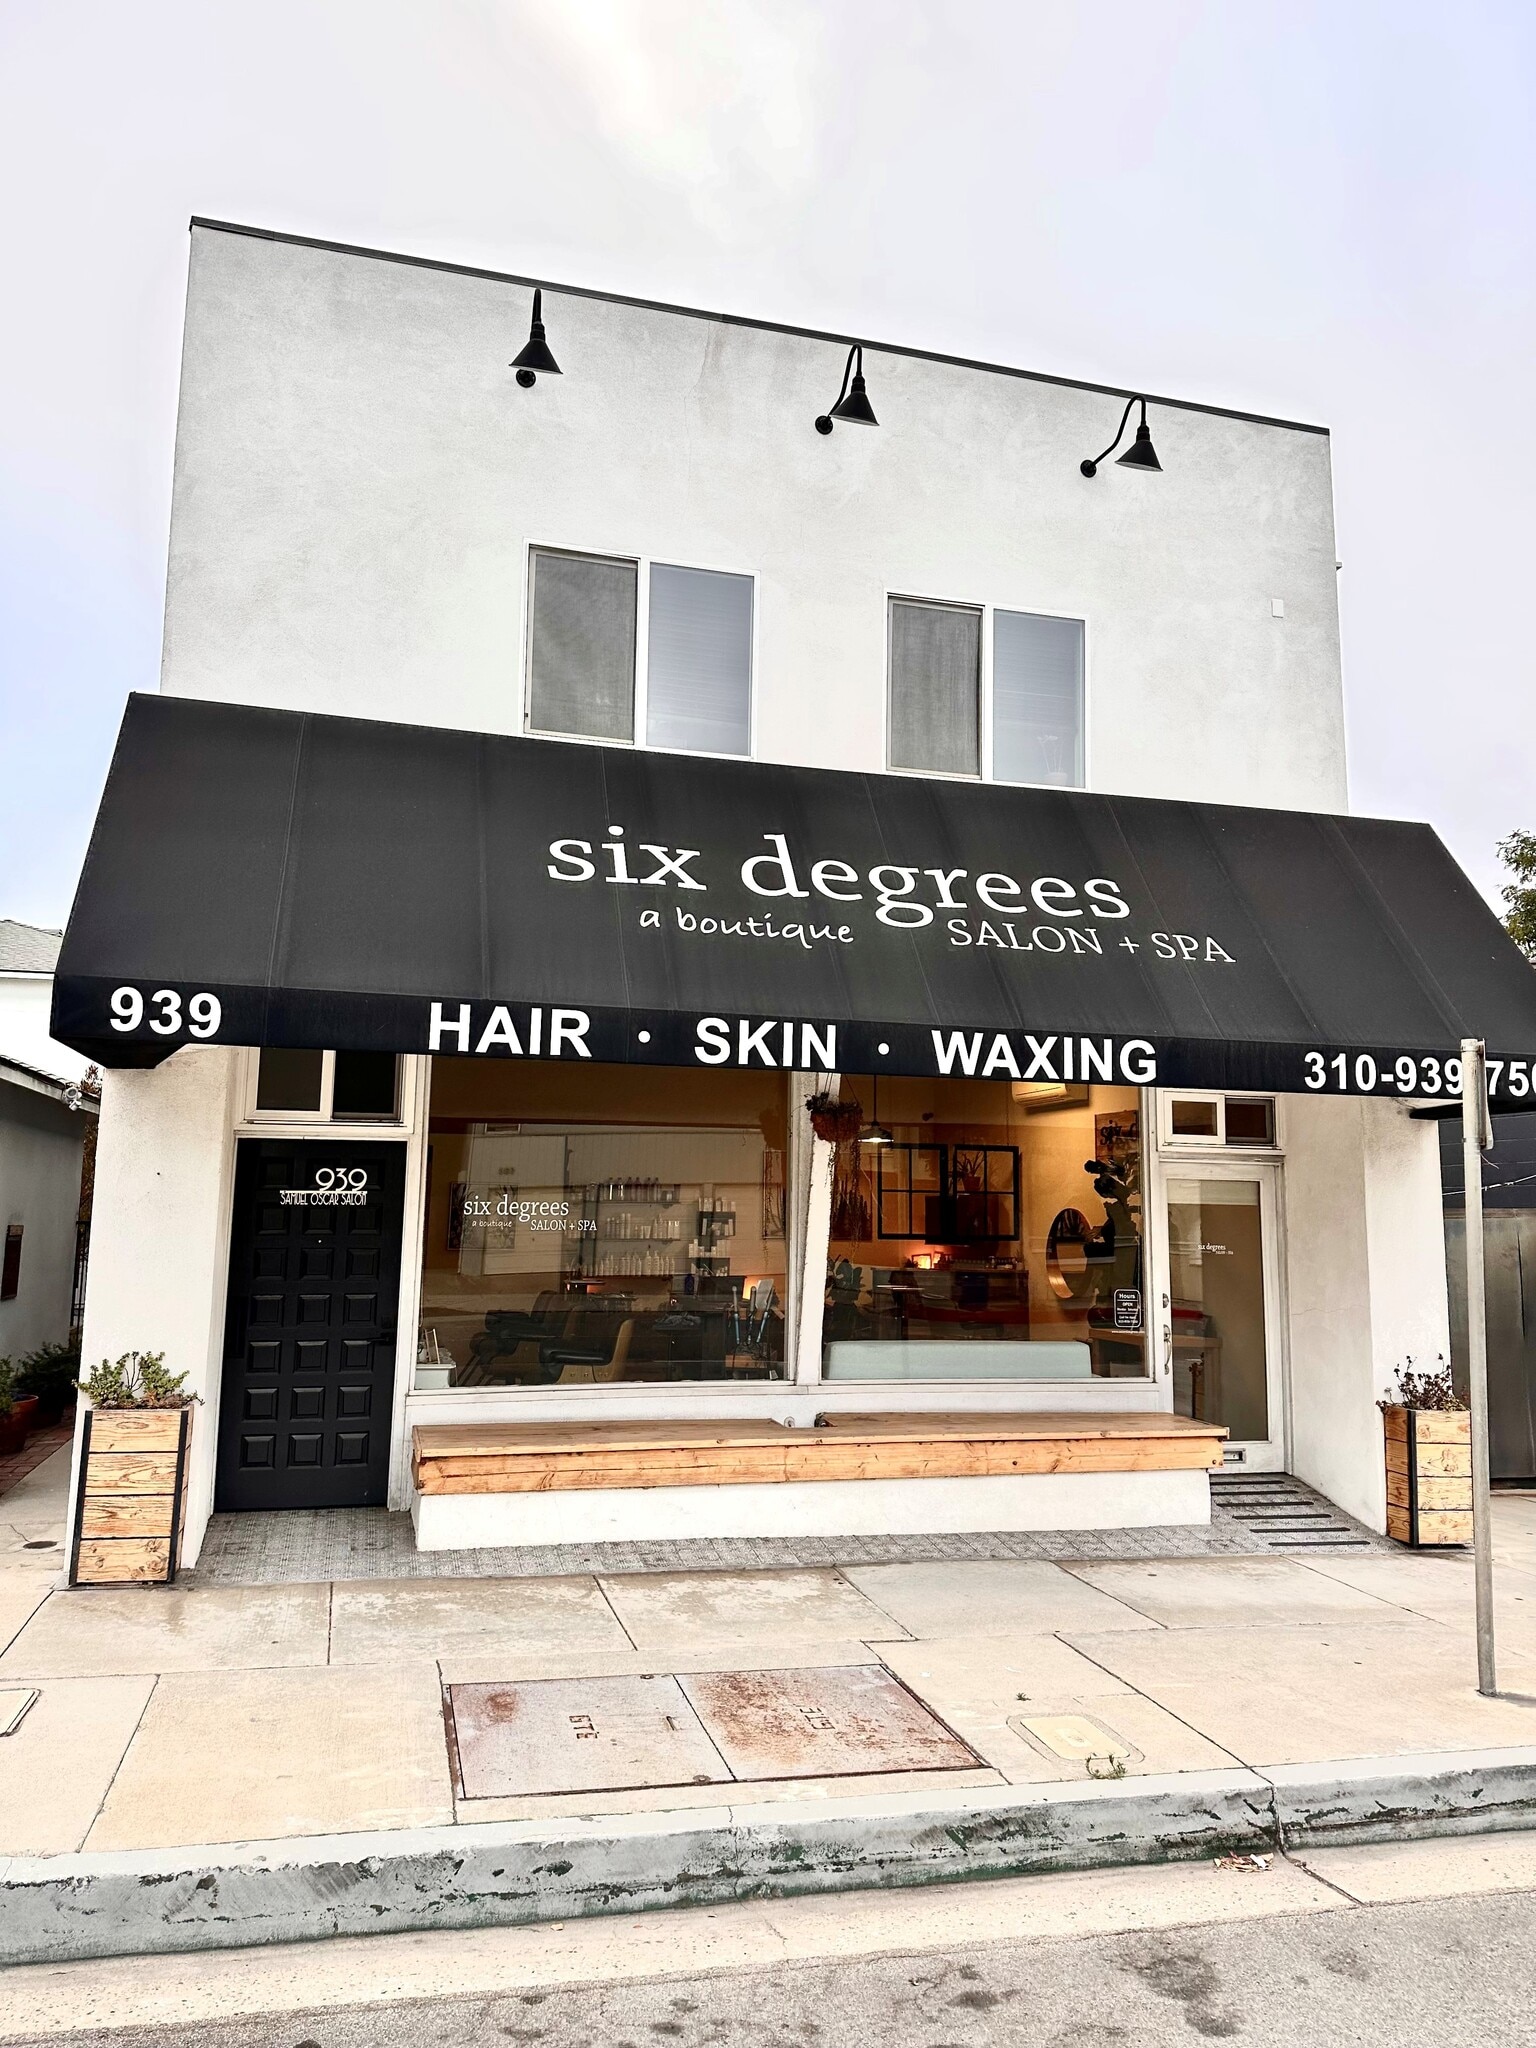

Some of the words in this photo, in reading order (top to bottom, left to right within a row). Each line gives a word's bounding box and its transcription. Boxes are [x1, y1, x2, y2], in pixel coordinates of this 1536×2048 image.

[547, 825, 706, 891] six
[740, 833, 1130, 928] degrees
[639, 910, 661, 928] a
[675, 906, 854, 948] boutique
[947, 918, 1103, 955] SALON
[1118, 936, 1140, 954] +
[1150, 932, 1237, 964] SPA
[109, 986, 222, 1039] 939
[428, 1002, 592, 1057] HAIR
[694, 1017, 836, 1070] SKIN
[931, 1029, 1157, 1084] WAXING
[315, 1167, 368, 1192] 939
[280, 1192, 308, 1206] SAMUEL
[310, 1192, 339, 1206] OSCAR
[340, 1192, 367, 1206] SALON
[463, 1195, 491, 1216] six
[496, 1194, 569, 1222] degrees
[479, 1219, 513, 1230] boutique
[530, 1219, 567, 1232] SALON
[577, 1219, 598, 1231] SPA
